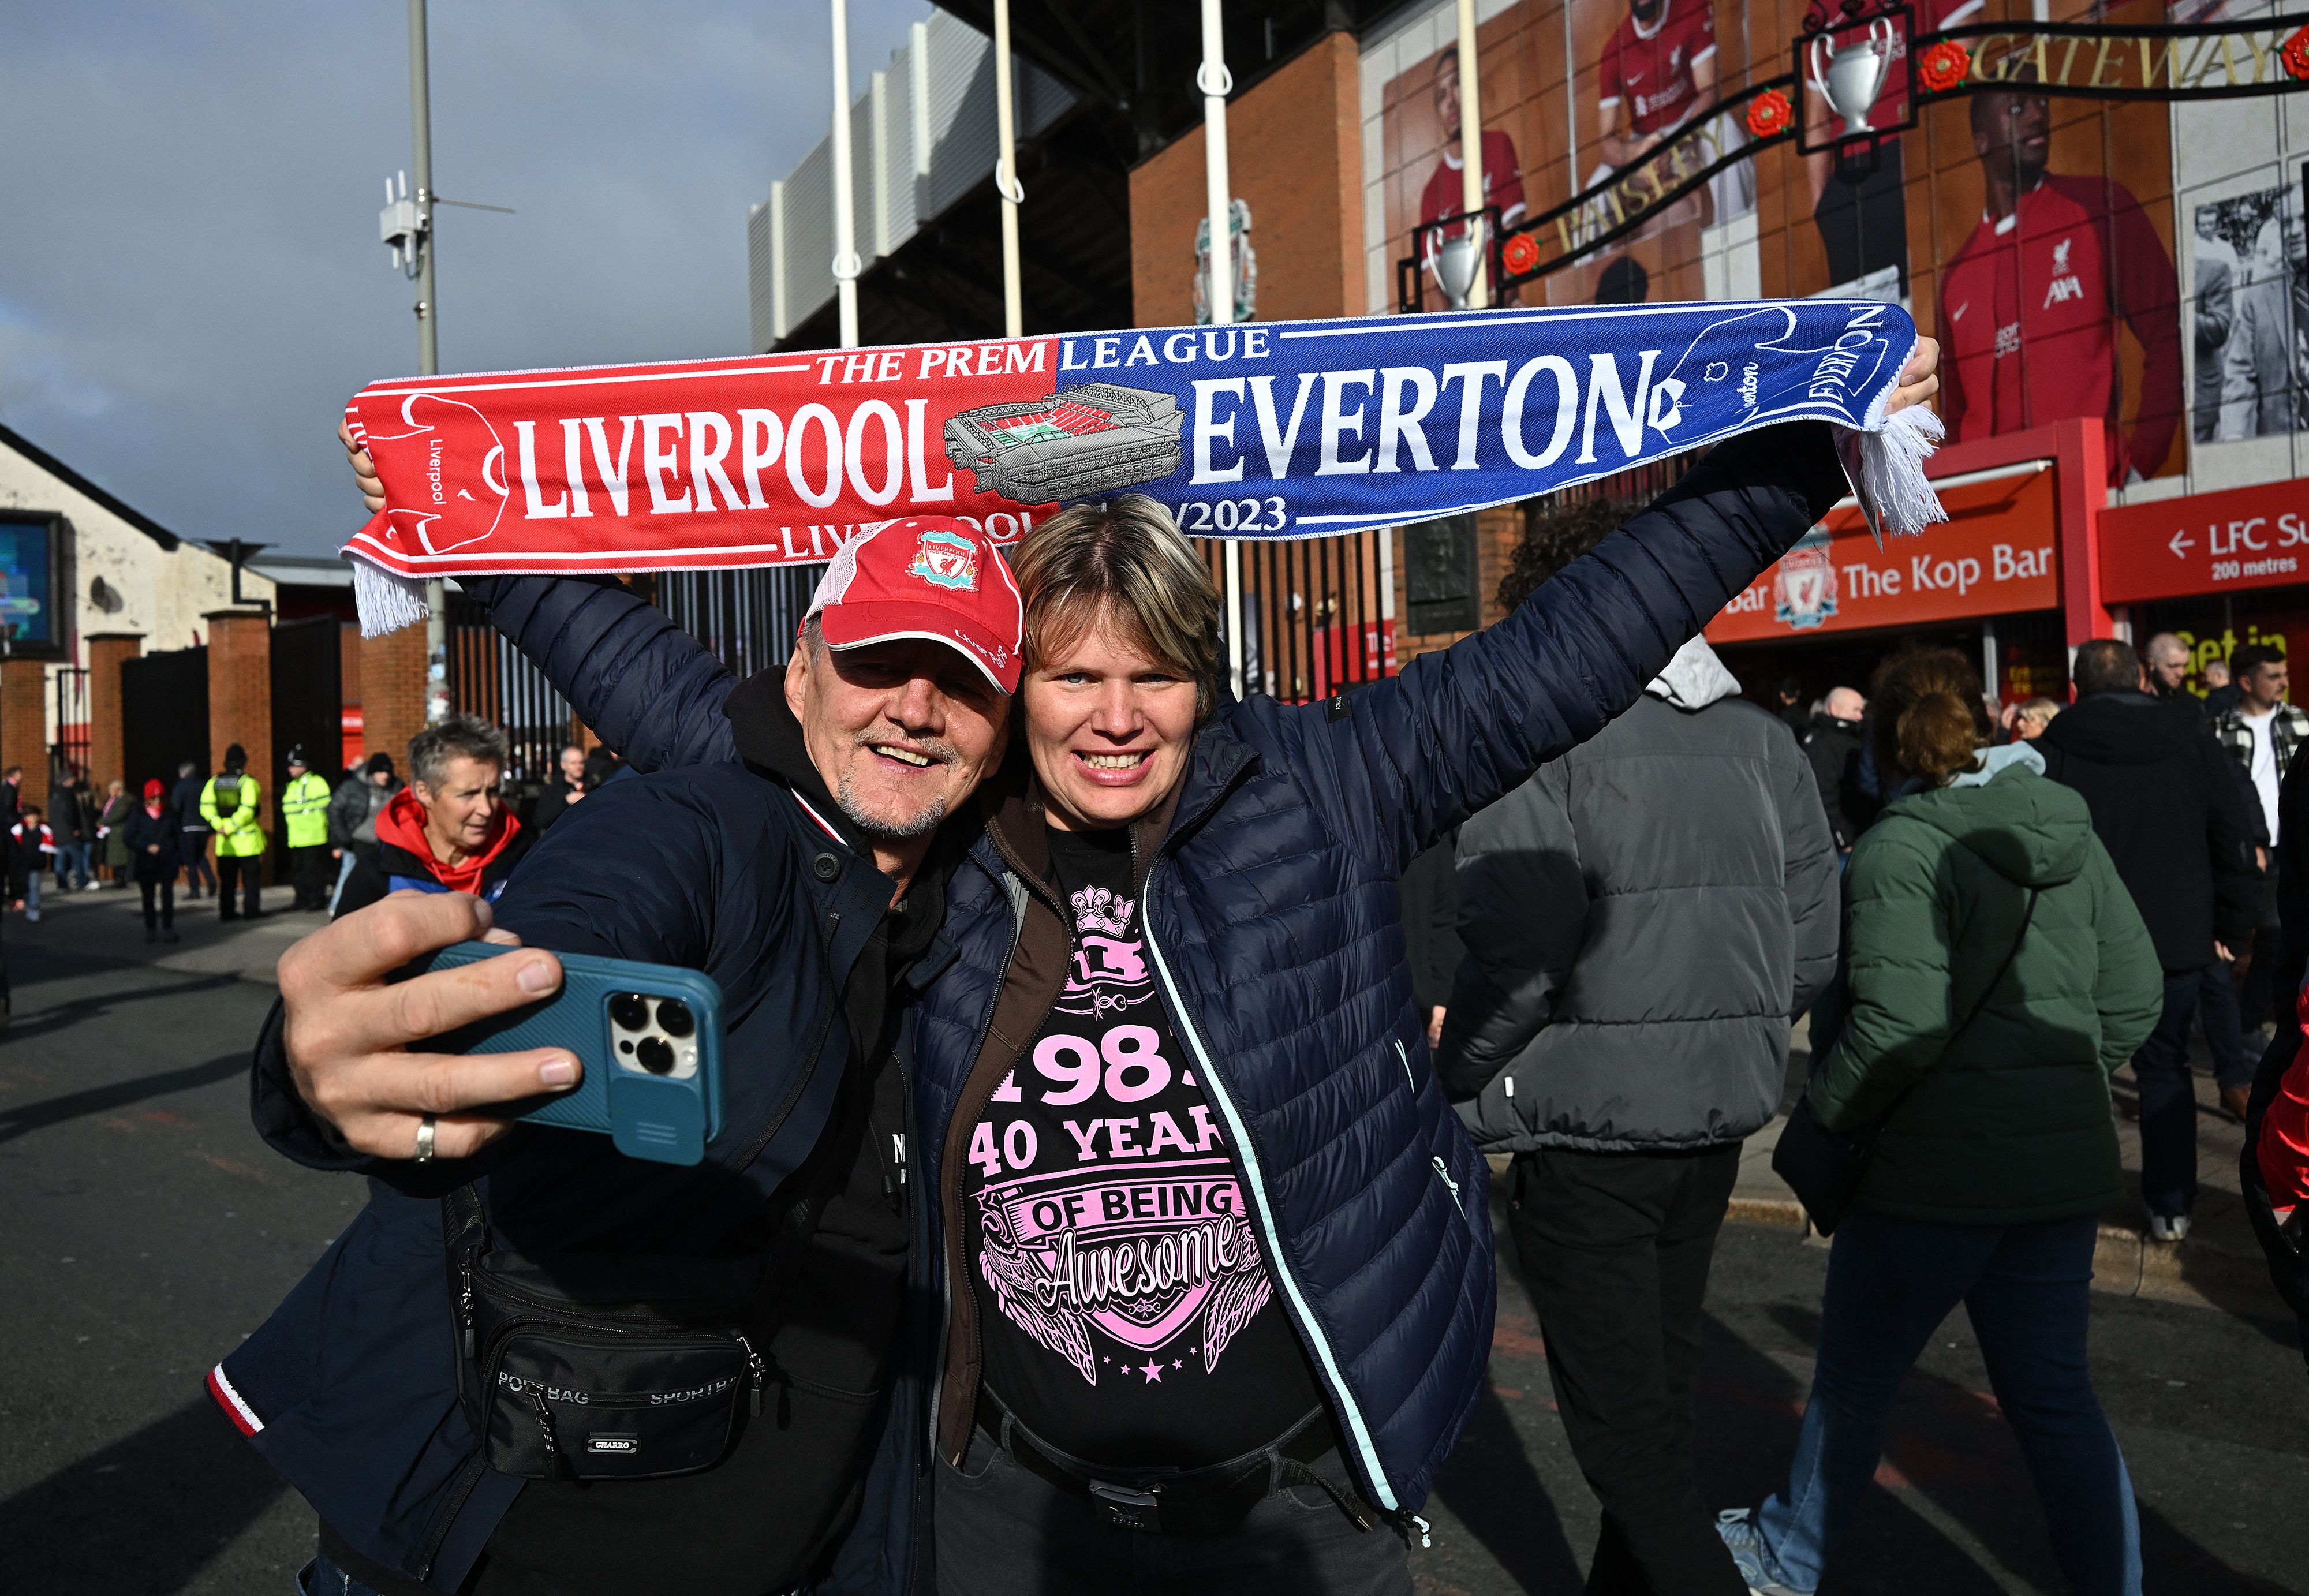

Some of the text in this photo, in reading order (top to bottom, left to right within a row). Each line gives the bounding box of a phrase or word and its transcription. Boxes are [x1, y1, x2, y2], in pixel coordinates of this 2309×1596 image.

[1971, 28, 2286, 89] GATEWAY
[1556, 114, 1724, 253] PAISLEY
[816, 328, 1271, 385] THE PREM LEAGUE
[1808, 305, 1886, 404] EVERTON
[1189, 350, 1661, 486] EVERTON
[426, 439, 447, 505] Liverpool
[513, 398, 954, 520] LIVERPOOL
[929, 544, 965, 556] LIVERPOOL
[2209, 517, 2269, 555] LFC
[1842, 543, 2053, 599] The Kop Bar
[2211, 556, 2298, 581] 200 metres
[991, 1025, 1200, 1106] 198
[968, 1119, 1038, 1178] 40
[1032, 1183, 1232, 1232] OF BEING
[1035, 1214, 1241, 1308] Awesome
